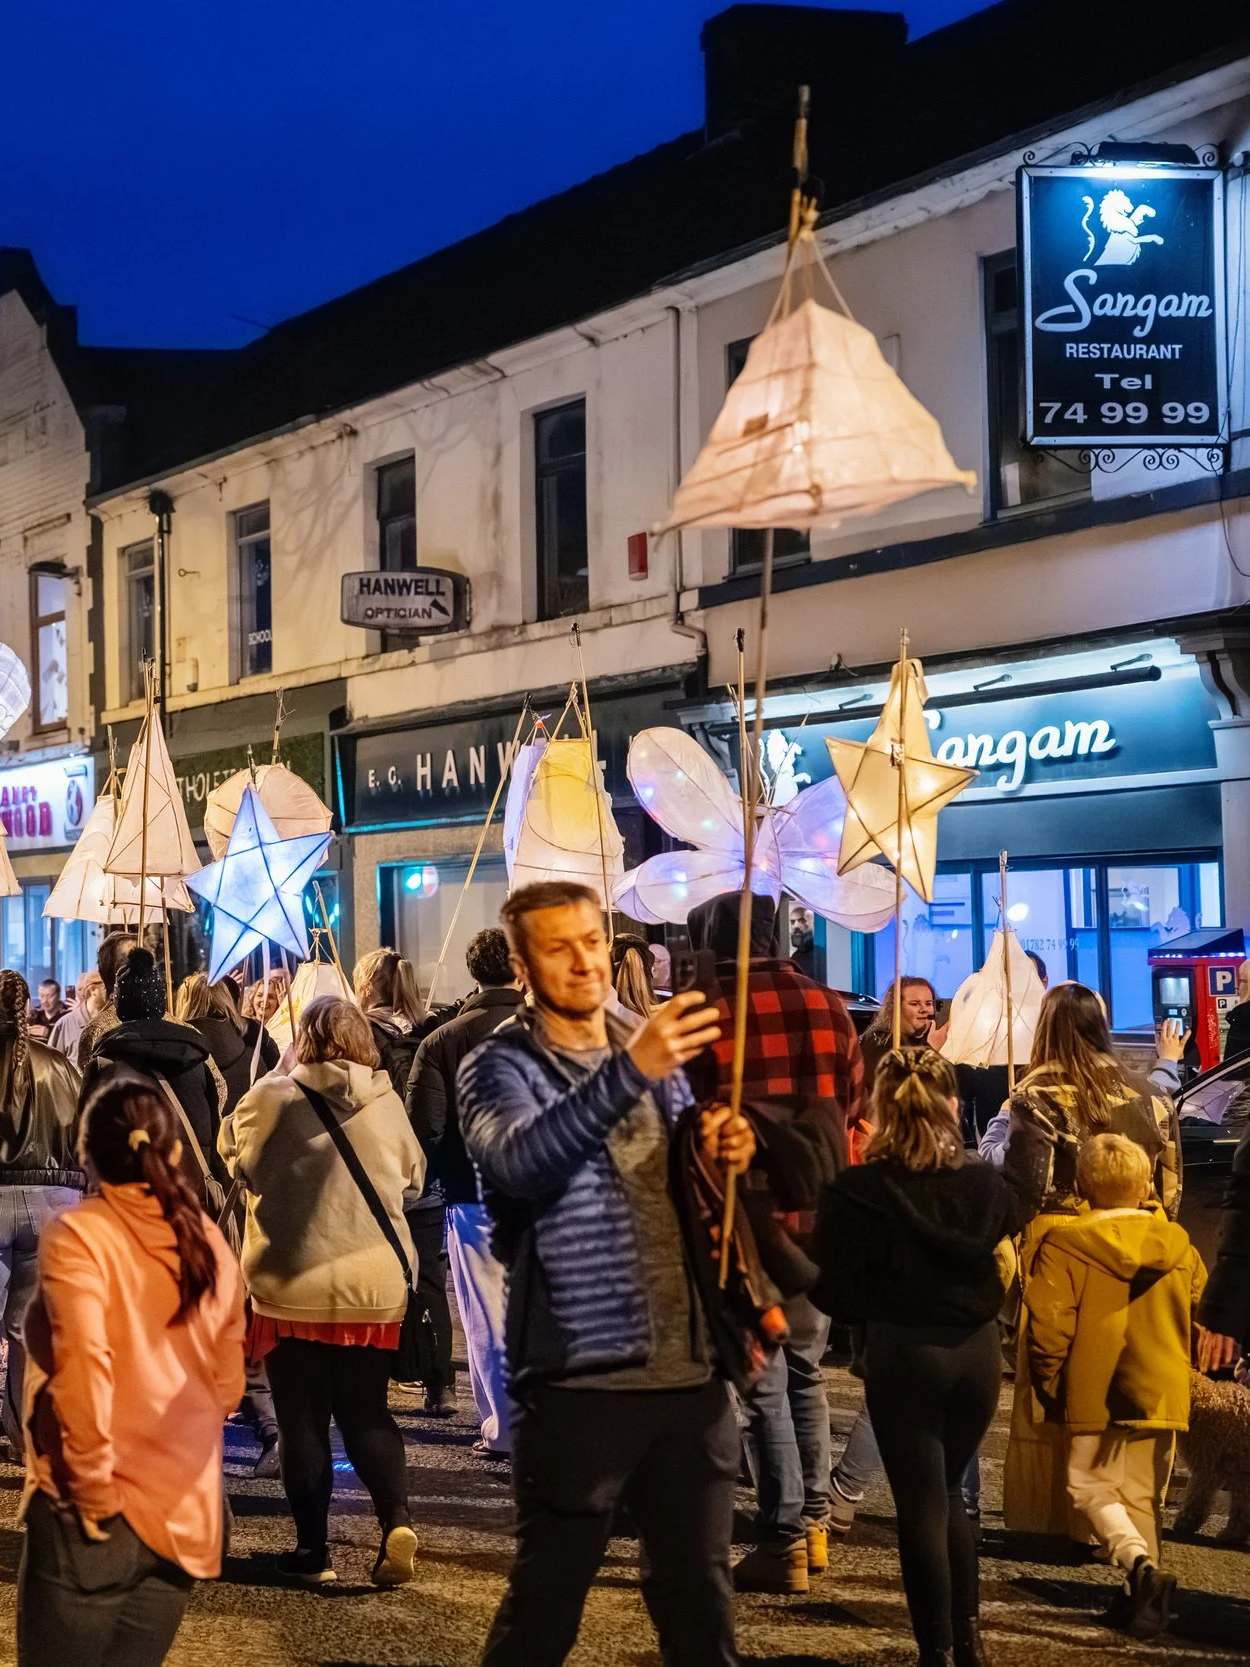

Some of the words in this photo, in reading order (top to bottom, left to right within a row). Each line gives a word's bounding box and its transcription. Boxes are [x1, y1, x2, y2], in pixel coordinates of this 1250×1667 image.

[1035, 268, 1213, 337] Sangam
[1065, 343, 1182, 360] RESTAURANT
[1095, 373, 1153, 390] Tel
[1039, 402, 1088, 424] 74
[1100, 402, 1148, 424] 99
[1161, 402, 1210, 424] 99
[359, 577, 446, 596] HANWELL
[365, 607, 432, 619] OPTICIAN
[368, 769, 380, 788] E.
[1069, 937, 1080, 951] 99
[1215, 970, 1233, 992] P
